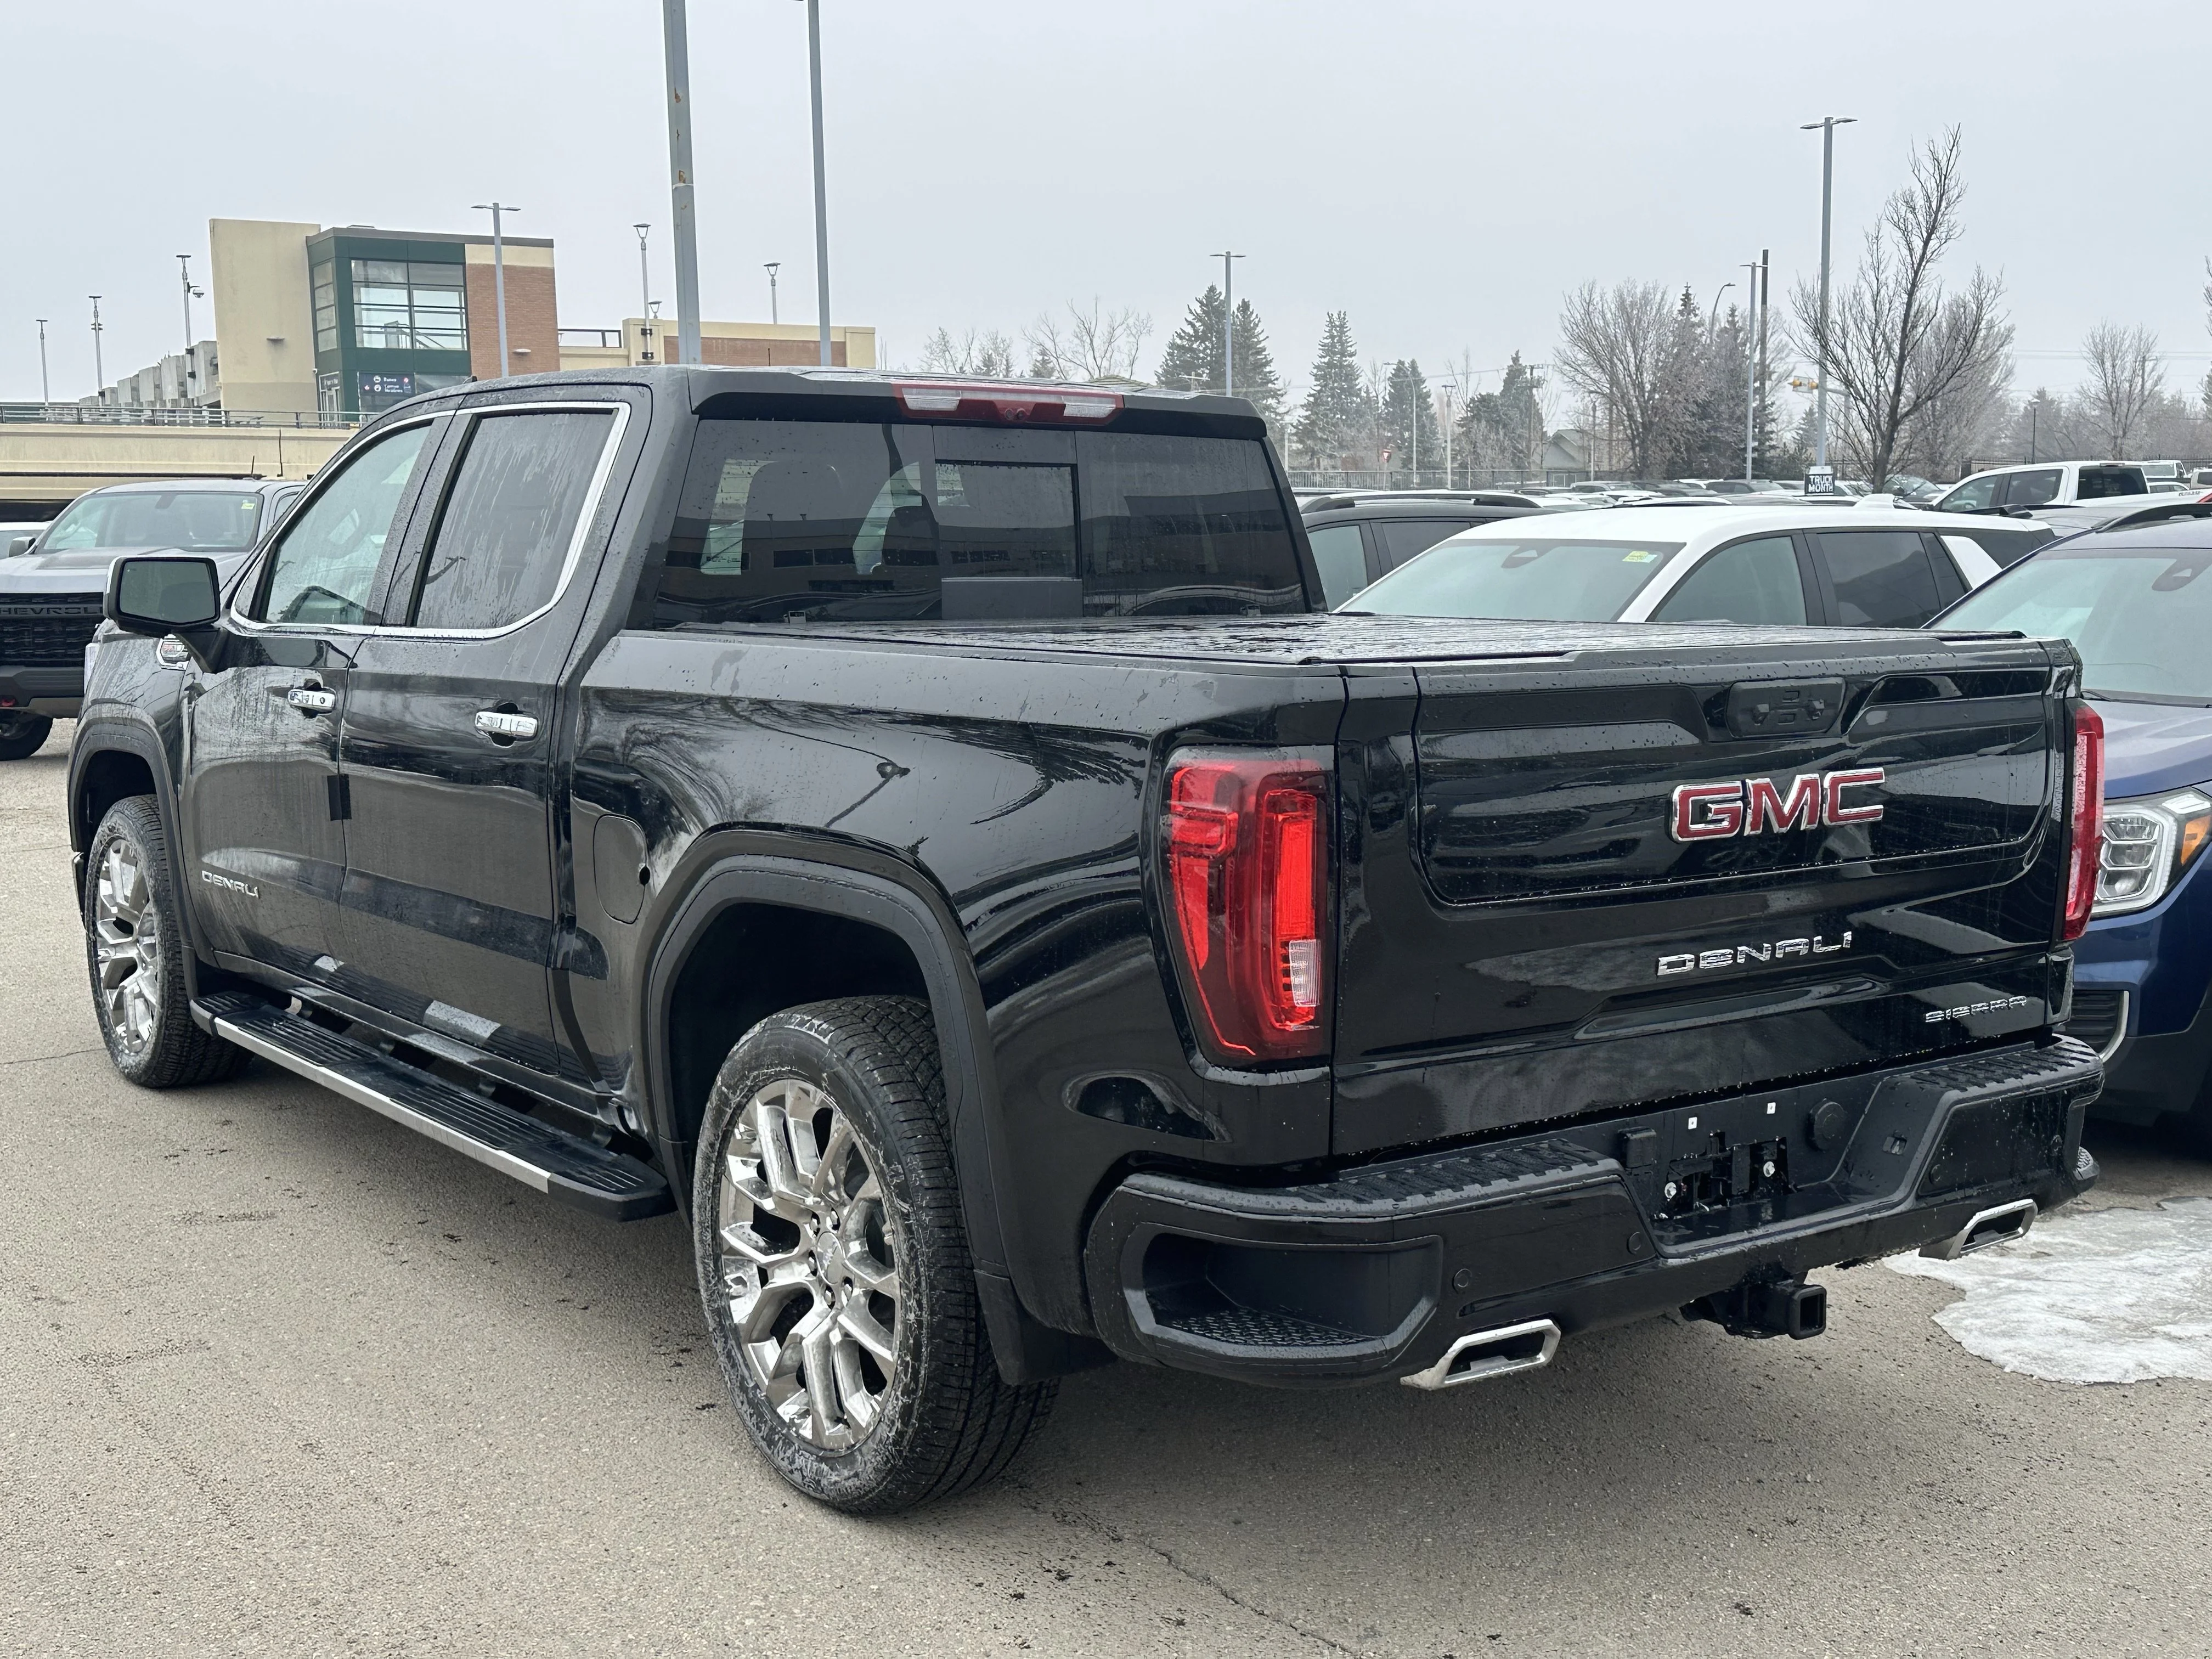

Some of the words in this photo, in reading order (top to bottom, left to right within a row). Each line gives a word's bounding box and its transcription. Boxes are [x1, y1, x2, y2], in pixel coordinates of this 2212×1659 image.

[1808, 483, 1833, 492] MONTH
[1809, 475, 1833, 484] TRUCK
[0, 606, 103, 615] HEVROL
[1671, 767, 1886, 842] GMC
[201, 870, 259, 898] DENALI
[1656, 931, 1852, 976] DENALI
[1925, 995, 2027, 1023] SIERRA
